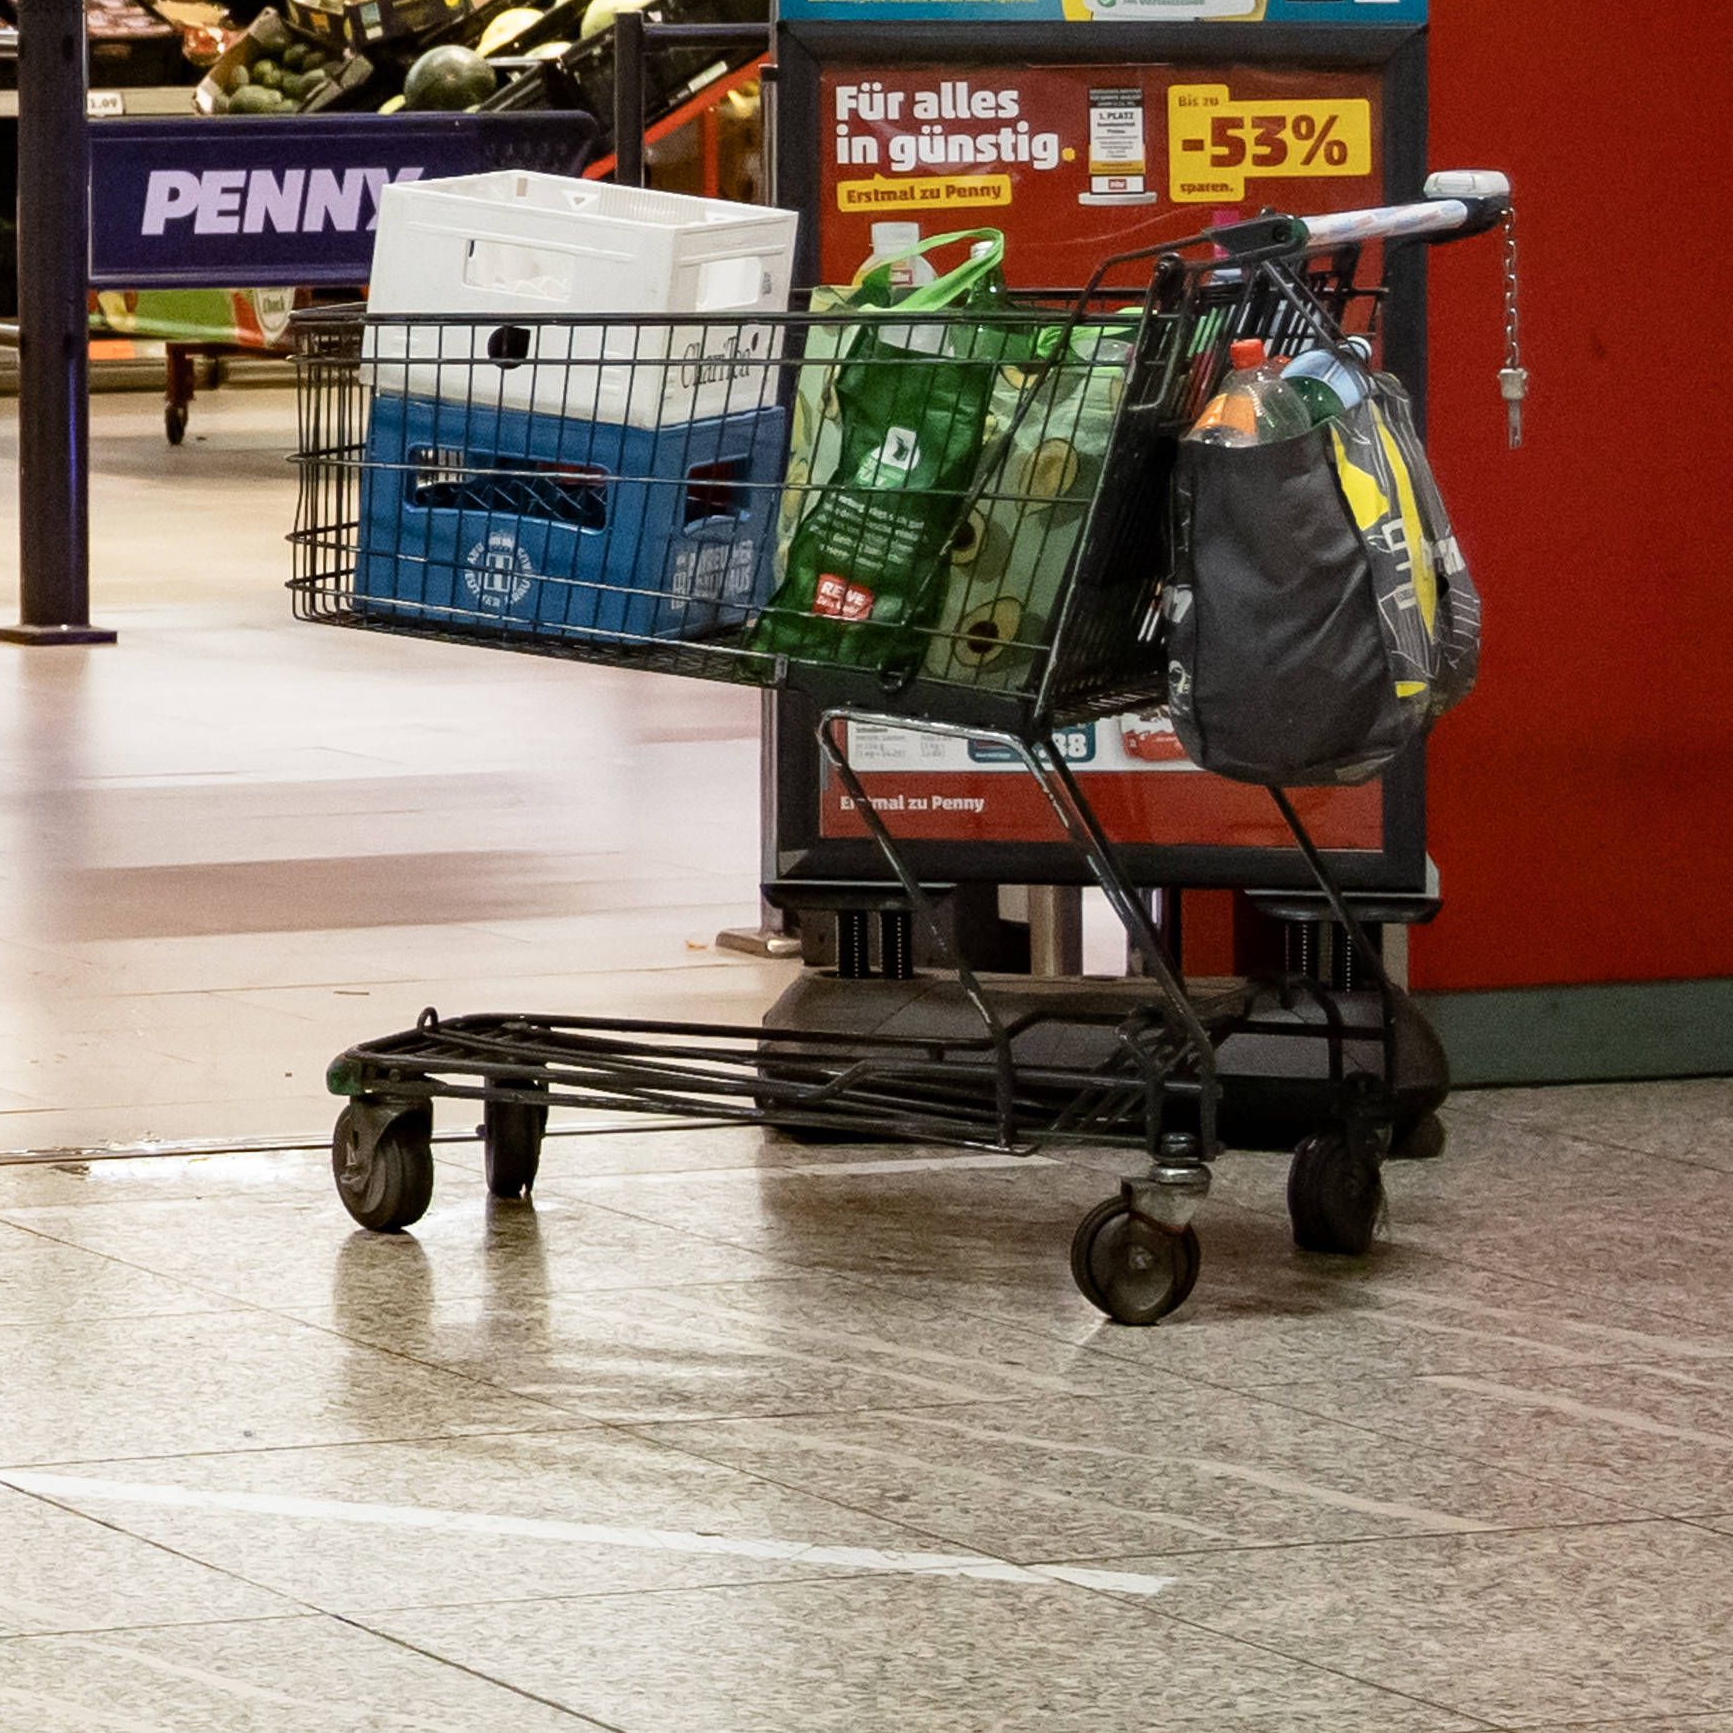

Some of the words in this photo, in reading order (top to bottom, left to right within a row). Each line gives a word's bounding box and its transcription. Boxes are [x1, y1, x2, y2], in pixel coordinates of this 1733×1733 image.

[835, 80, 903, 122] Für
[914, 81, 1020, 120] alles
[835, 125, 878, 165] in
[888, 121, 1077, 171] günstig.
[1181, 113, 1349, 169] -53%
[846, 185, 916, 205] Erstmal
[920, 186, 941, 200] zu
[945, 183, 1001, 203] Penny
[907, 798, 928, 811] zu
[932, 795, 985, 813] Penny
